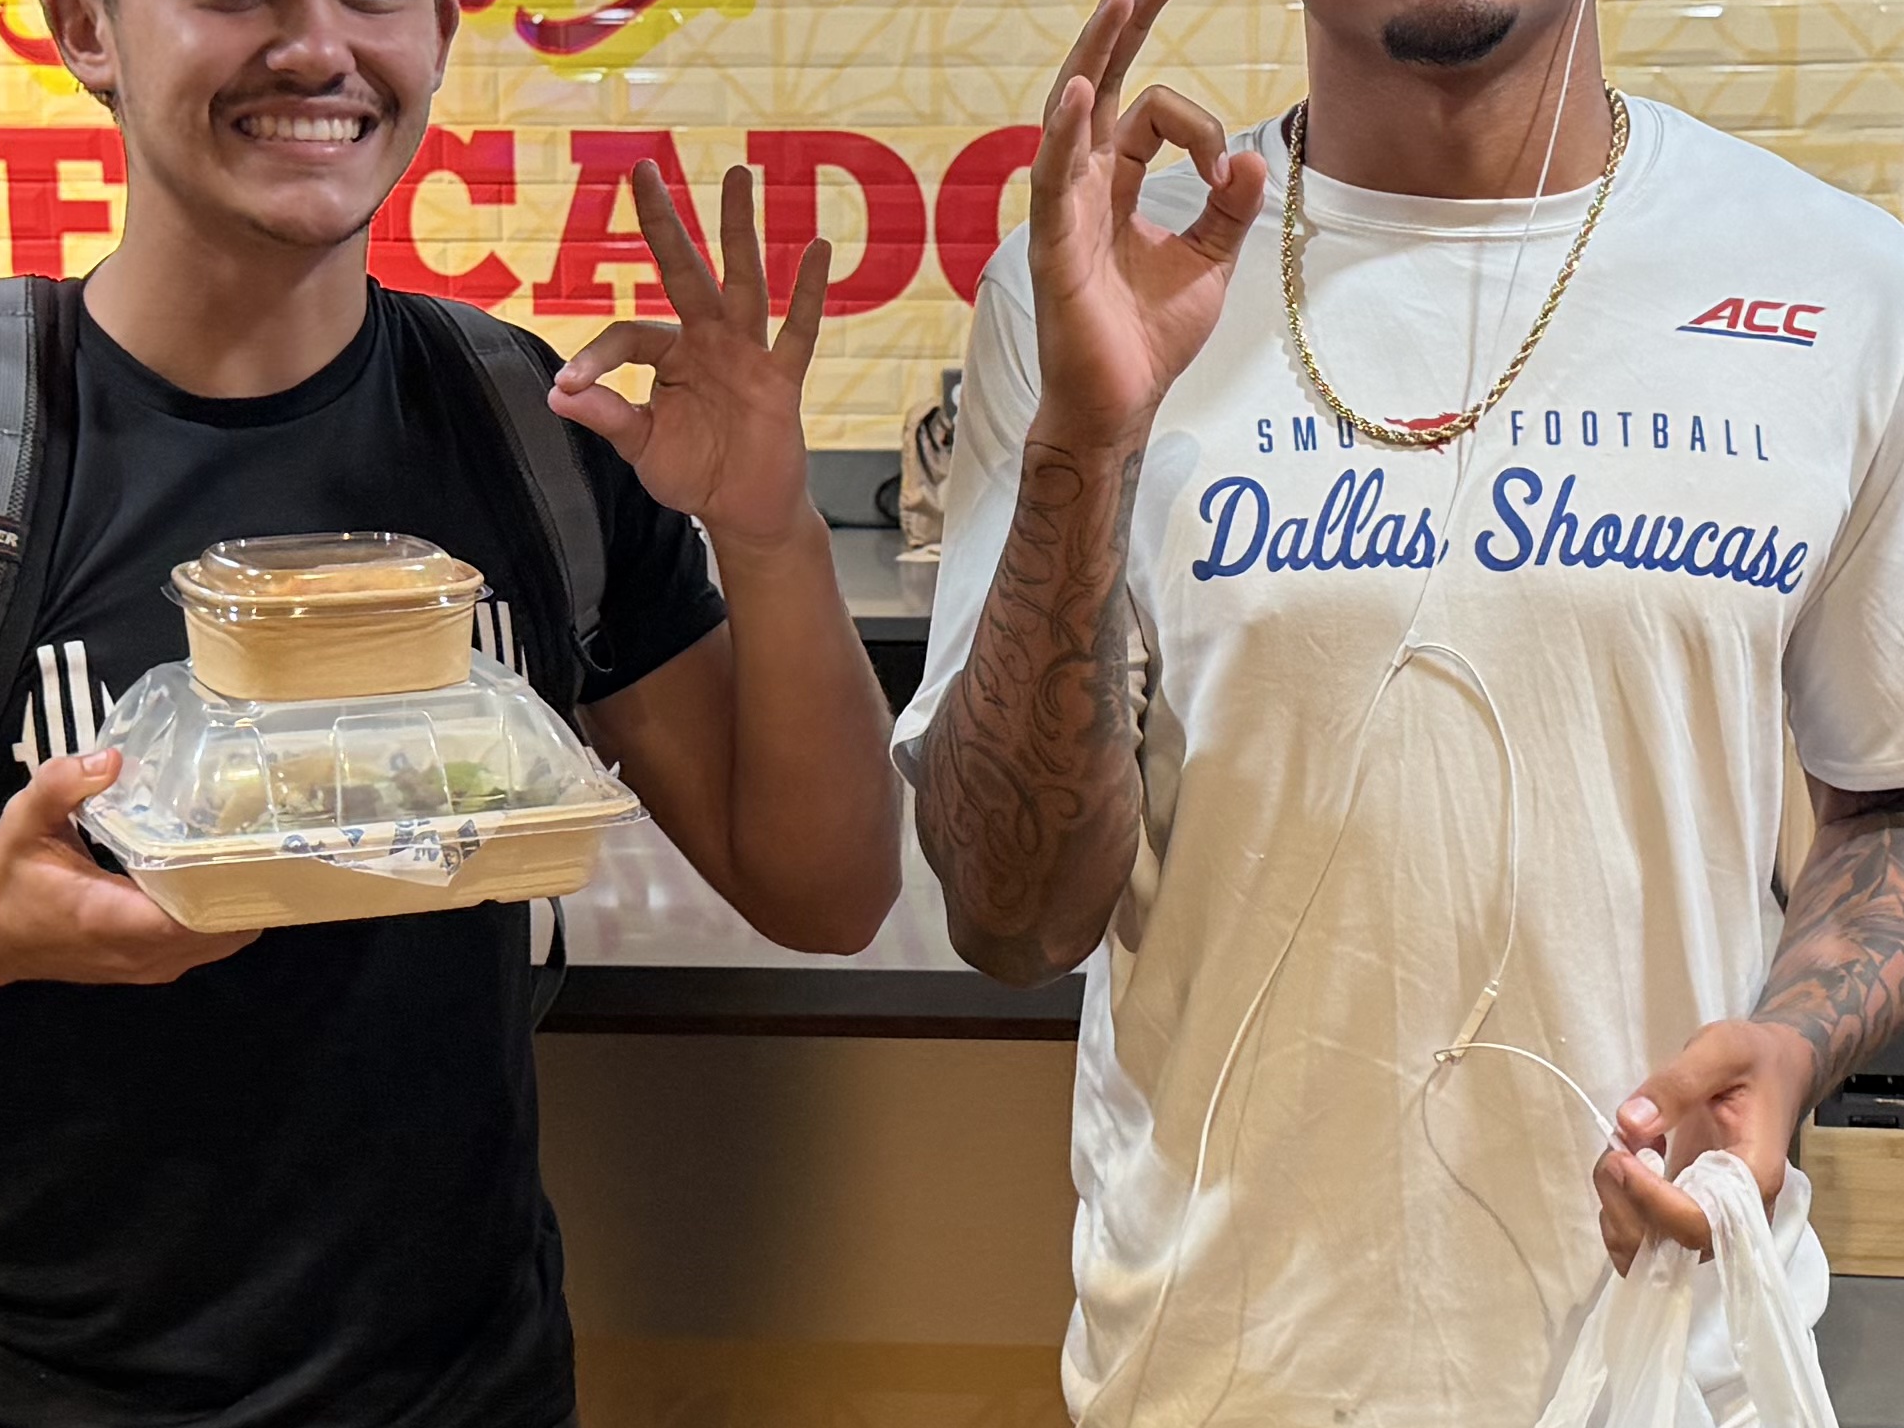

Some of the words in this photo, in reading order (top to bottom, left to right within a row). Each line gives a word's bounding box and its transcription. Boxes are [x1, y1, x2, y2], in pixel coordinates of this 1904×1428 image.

[1686, 297, 1827, 341] ACC
[1257, 416, 1353, 454] SMU
[1511, 409, 1769, 462] FOOTBALL
[1191, 467, 1449, 582] Dallas
[1474, 466, 1810, 595] Showcase
